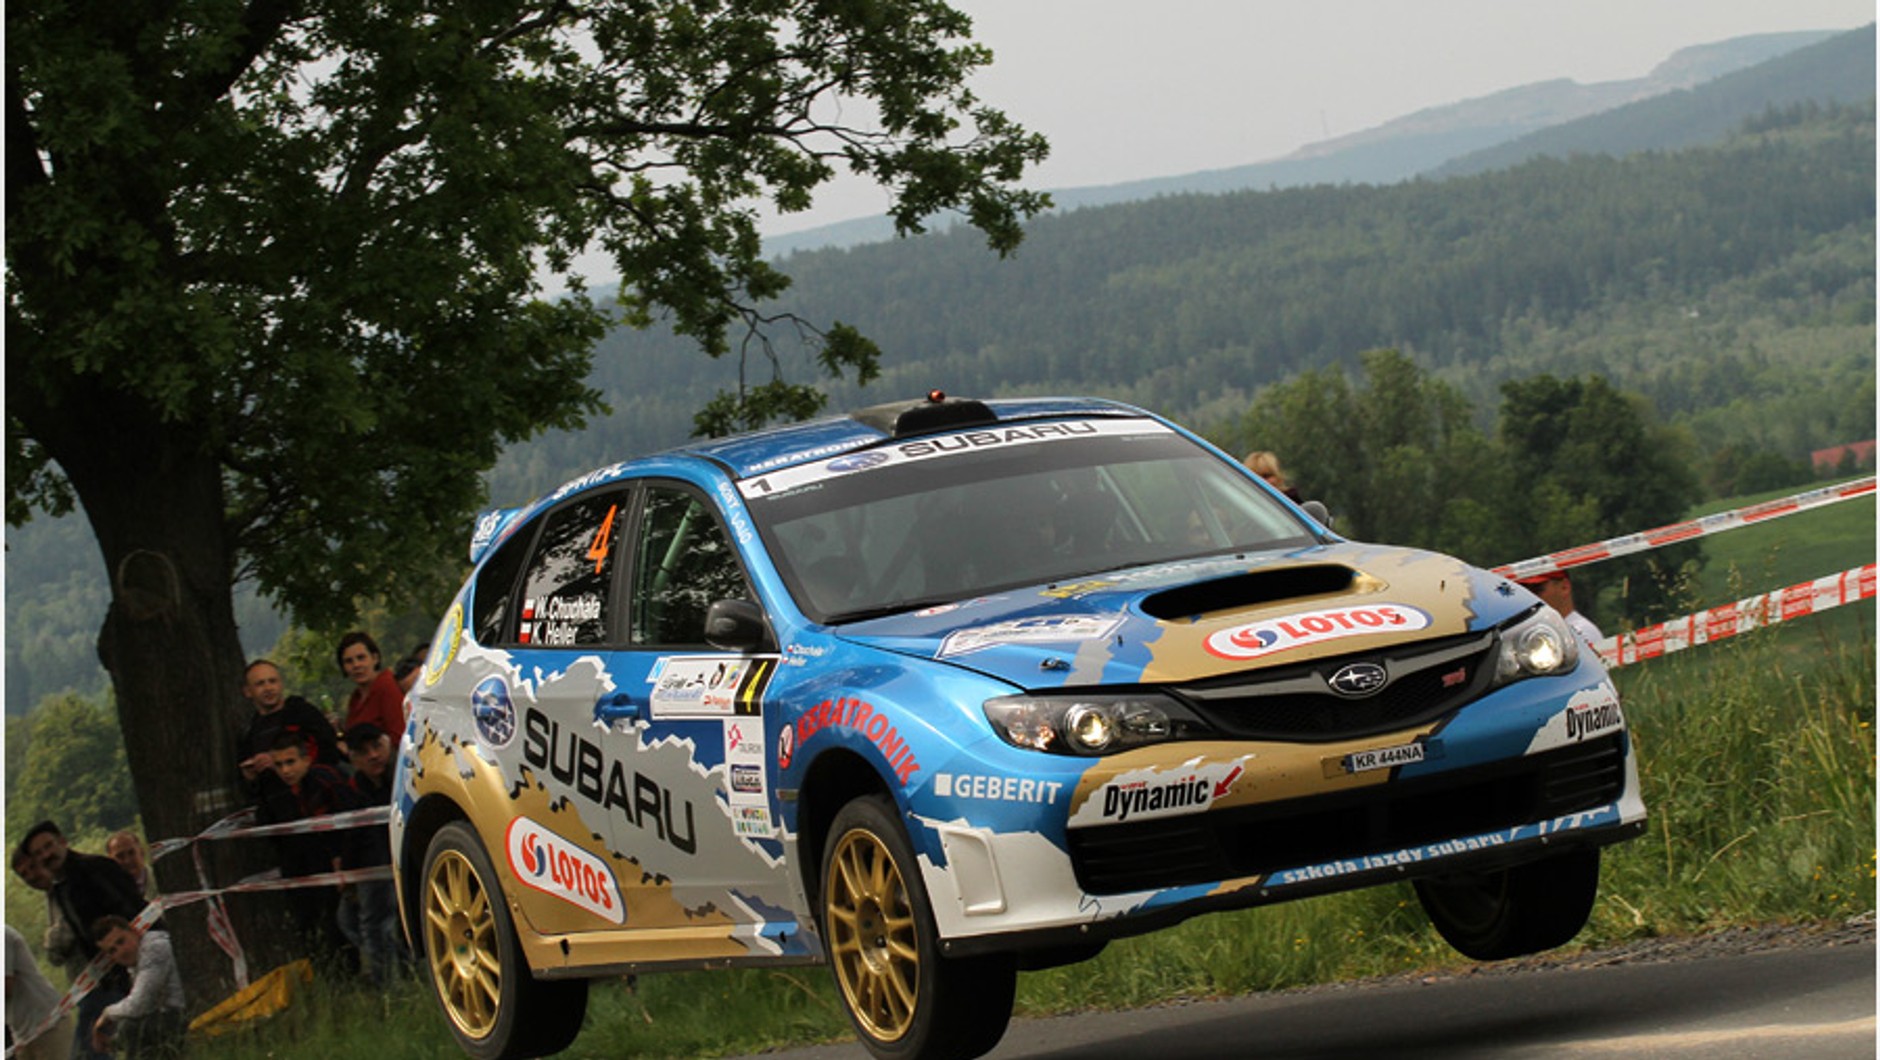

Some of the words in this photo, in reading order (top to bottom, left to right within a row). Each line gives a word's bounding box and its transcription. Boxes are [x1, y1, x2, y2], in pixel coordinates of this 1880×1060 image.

[898, 421, 1098, 459] SUBARU
[750, 477, 773, 493] 1
[586, 503, 618, 575] 4
[1277, 607, 1407, 639] LOTOS
[796, 696, 920, 787] KERATRONIK
[1354, 753, 1376, 769] KR
[1379, 745, 1422, 763] 444NA
[525, 707, 697, 855] SUBARU
[954, 773, 1063, 804] GEBERIT
[1102, 775, 1209, 821] Dynamic
[1427, 831, 1505, 858] subaru
[548, 842, 613, 911] LOTOS
